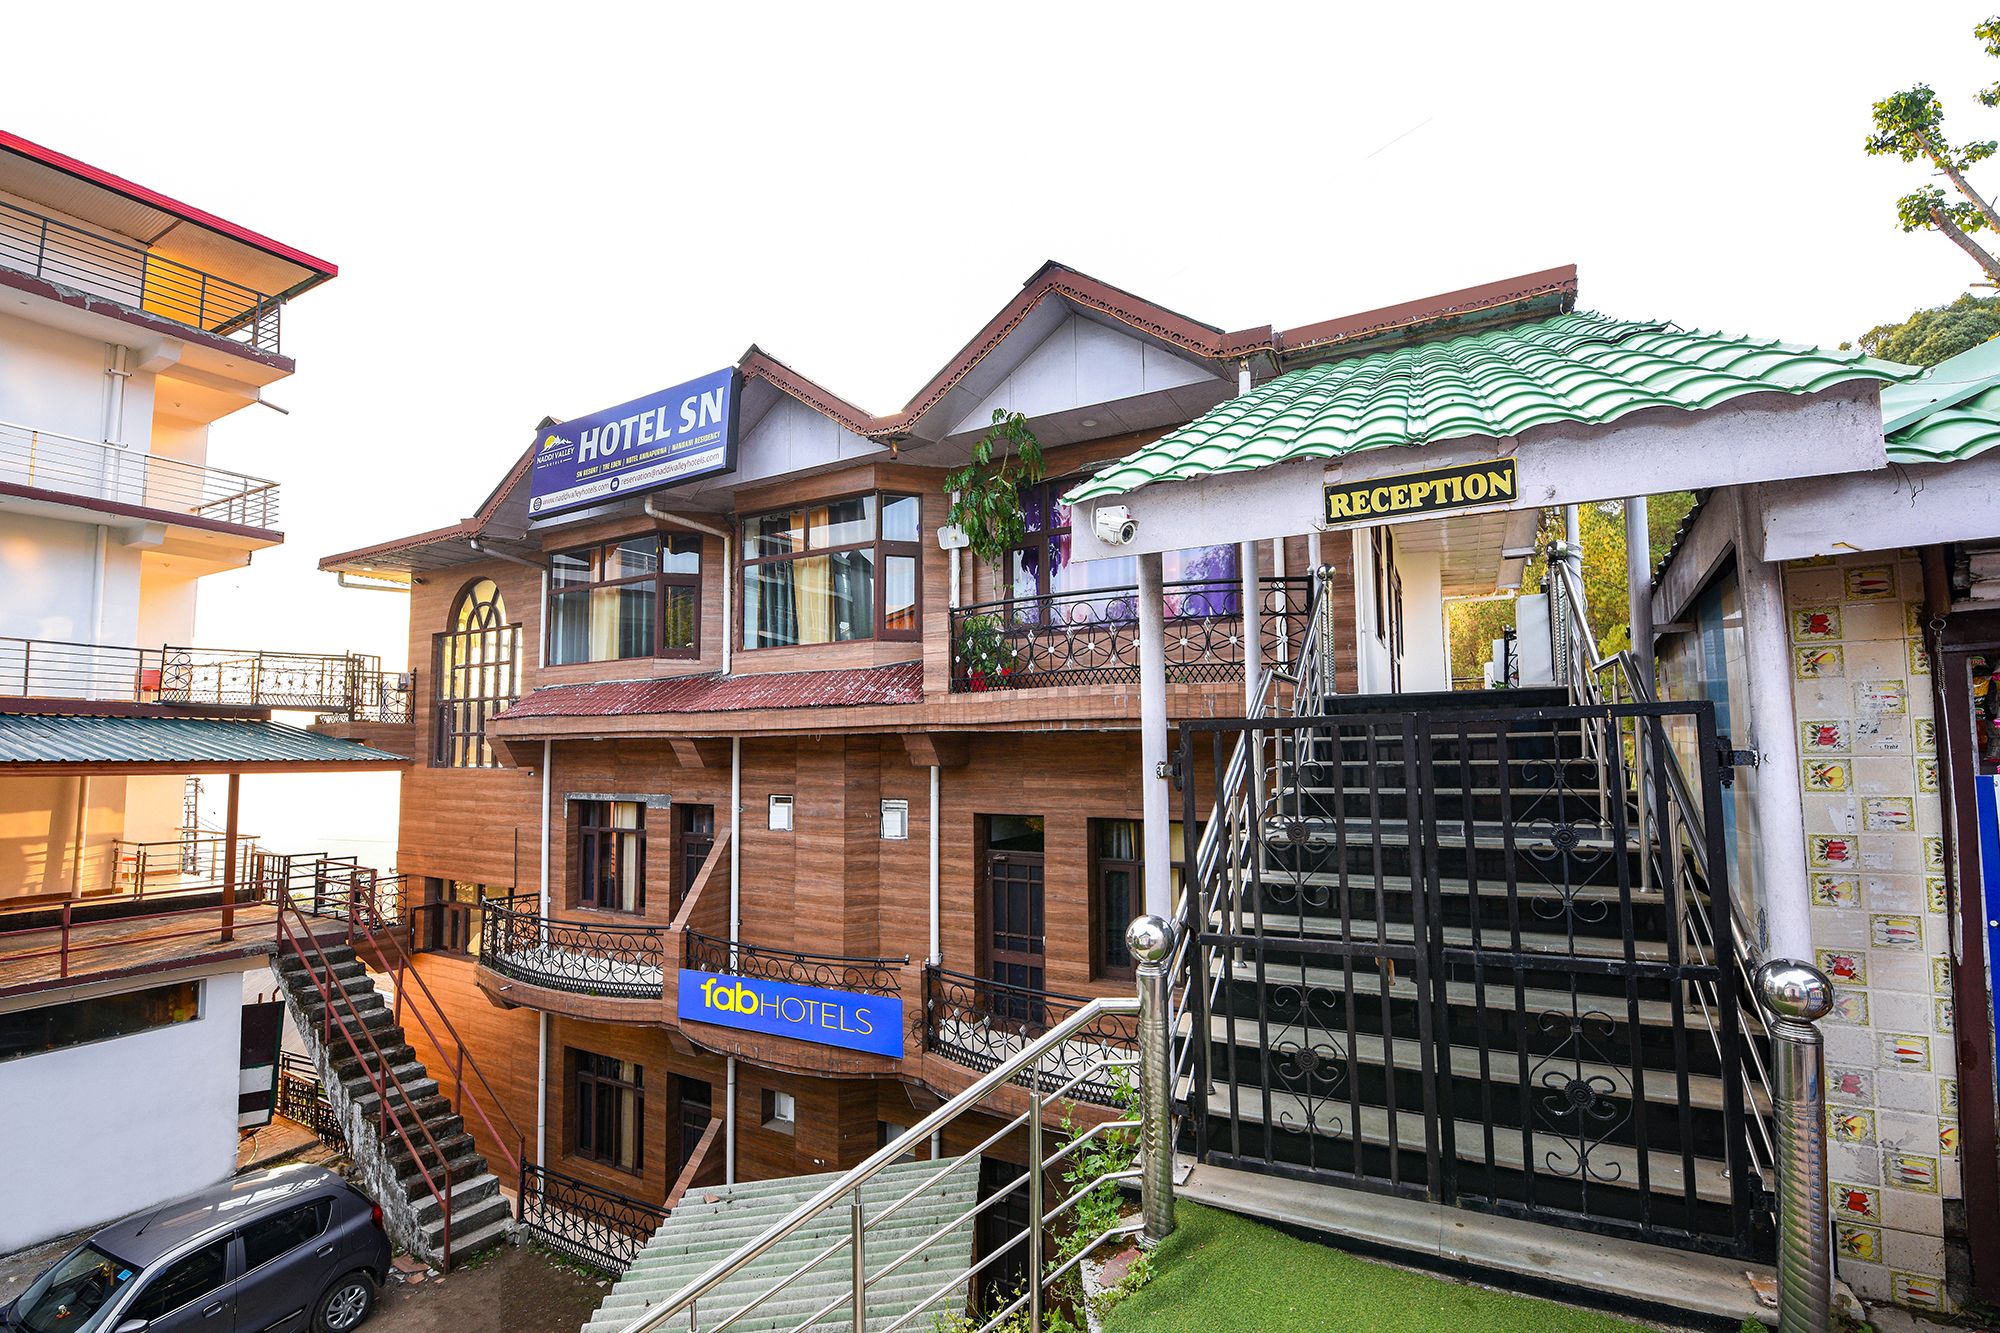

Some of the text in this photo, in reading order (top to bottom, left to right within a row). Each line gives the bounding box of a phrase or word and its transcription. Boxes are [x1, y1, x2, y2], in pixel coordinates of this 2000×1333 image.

[577, 386, 725, 464] HOTEL SN
[536, 446, 576, 464] NADDI VALLEY
[620, 452, 720, 486] reservation@naddivalleyhotels.com
[1329, 469, 1512, 518] RECEPTION
